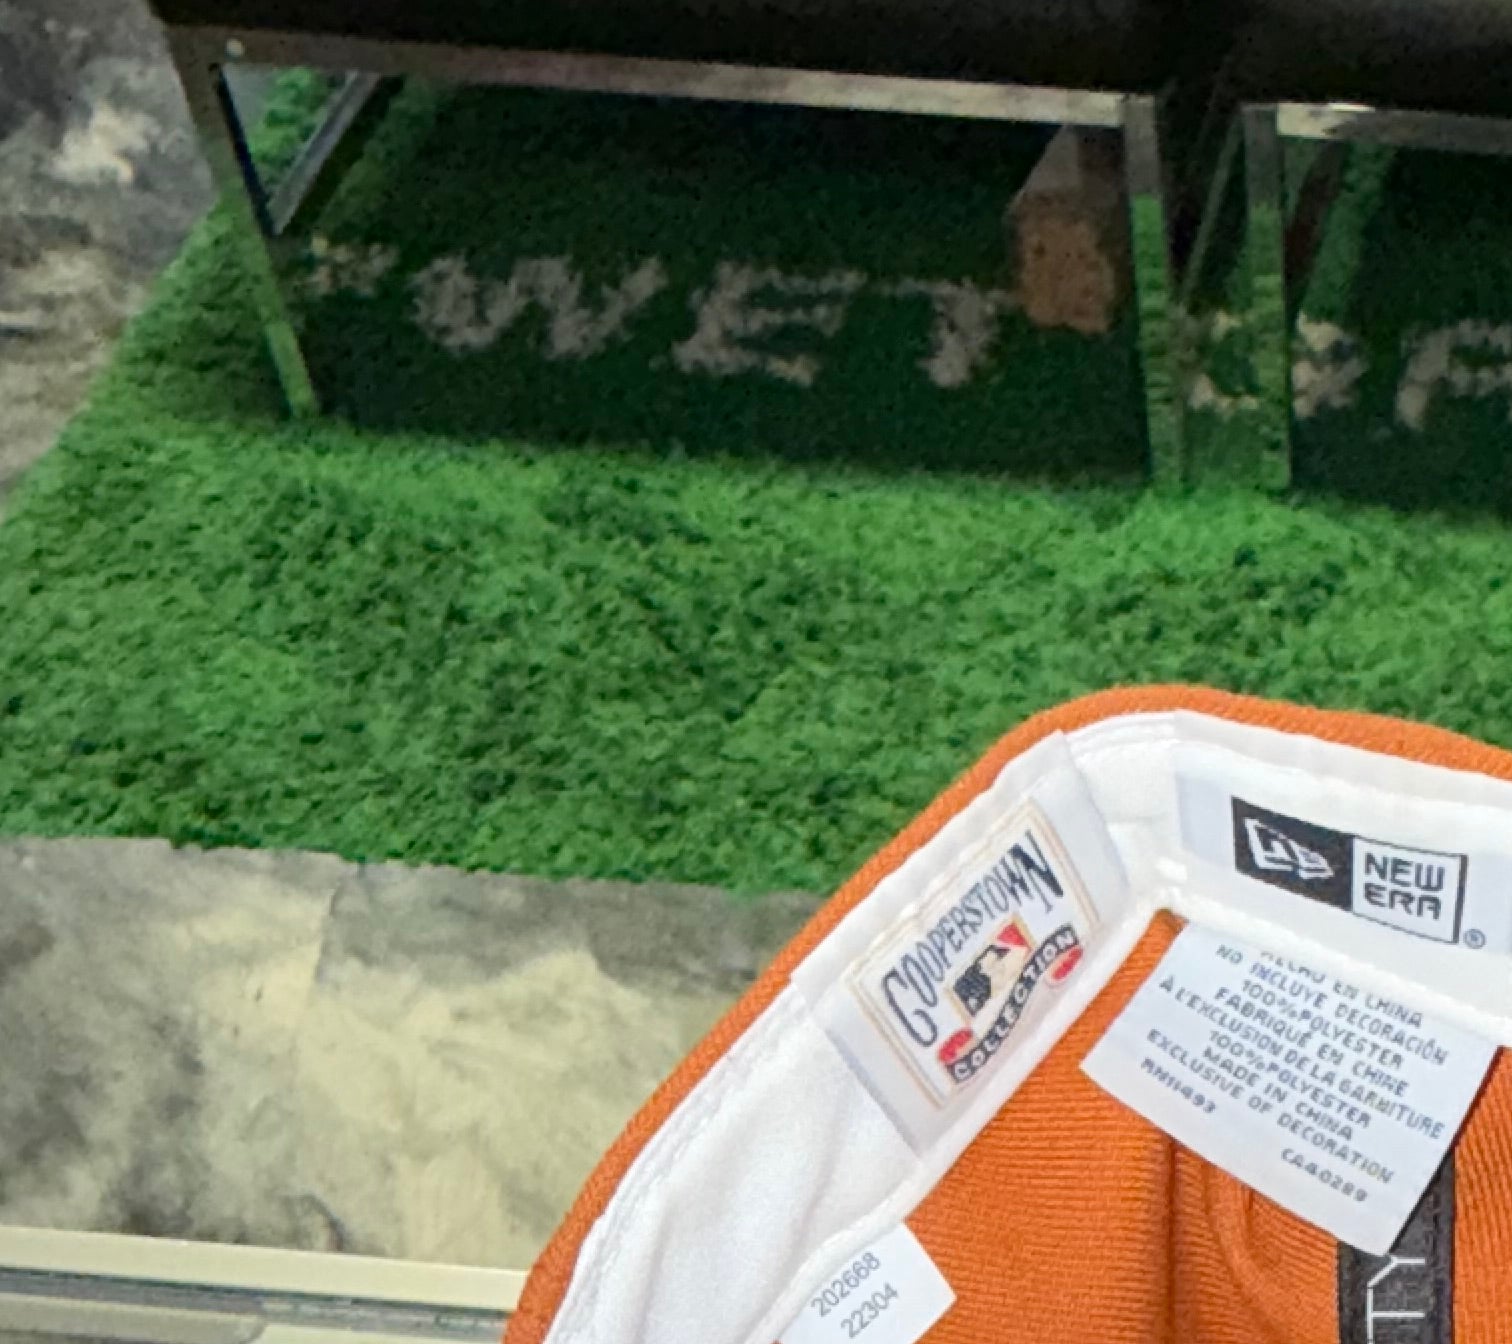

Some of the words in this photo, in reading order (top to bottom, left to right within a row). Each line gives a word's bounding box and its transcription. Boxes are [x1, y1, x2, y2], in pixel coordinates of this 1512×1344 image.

[1364, 883, 1443, 920] ERA
[1365, 853, 1446, 892] NEW
[881, 829, 1064, 1047] COOPERSTOWN
[950, 925, 1079, 1082] COLLECTION
[1215, 987, 1313, 1048] FABRIQUÉ
[1317, 1043, 1344, 1066] EN
[1352, 1060, 1409, 1096] CHINE
[1216, 944, 1243, 965] NO
[1250, 962, 1328, 1008] INCLUYE
[1335, 1002, 1449, 1065] DECORACIÓN
[1243, 979, 1404, 1069] 100%POLYESTER
[1365, 993, 1423, 1029] CHINA
[1147, 1028, 1245, 1099] EXCLUSIVE
[1248, 1095, 1273, 1114] OF
[1277, 1112, 1395, 1184] DECORATION
[1203, 1046, 1260, 1087] MADE
[1264, 1082, 1288, 1104] IN
[1295, 1102, 1353, 1140] CHINA
[1211, 1030, 1372, 1128] 100%POLYESTER
[1285, 1049, 1310, 1071] DE
[1310, 1064, 1336, 1086] LA
[1338, 1078, 1446, 1140] GARNITURE
[811, 1252, 881, 1317] 202668
[840, 1282, 899, 1339] 22304
